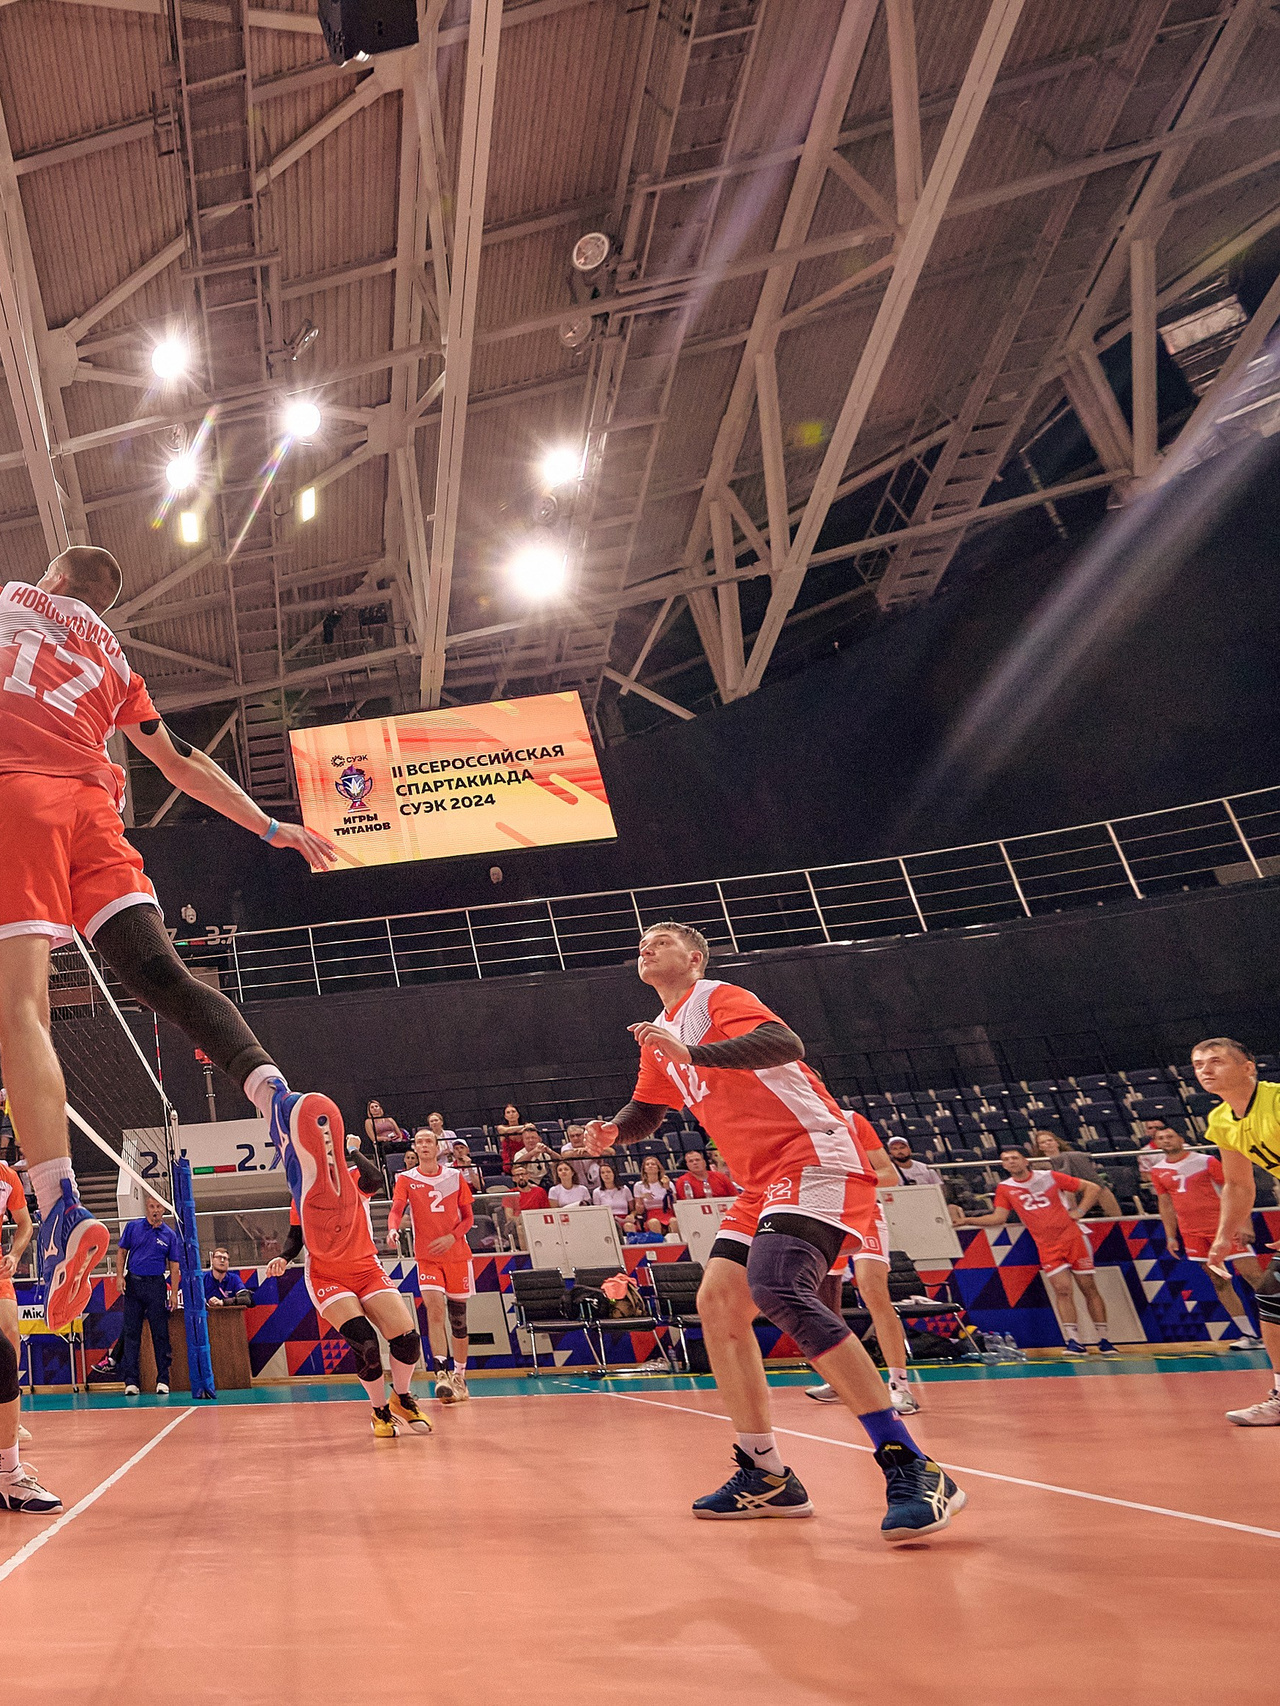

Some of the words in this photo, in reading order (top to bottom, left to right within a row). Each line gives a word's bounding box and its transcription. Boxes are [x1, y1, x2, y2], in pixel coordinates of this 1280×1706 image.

[3, 629, 106, 717] 17
[346, 754, 368, 763] СУЭК
[406, 744, 565, 776] ВСЕРОССИЙСКАЯ
[395, 768, 535, 797] СПАРТАКИАДА
[399, 798, 447, 816] СУЭК
[450, 793, 496, 810] 2024
[333, 822, 392, 836] ТИТАНОВ
[343, 813, 378, 825] ИГРЫ
[666, 1061, 711, 1108] 12
[1171, 1174, 1186, 1193] 7
[428, 1190, 445, 1213] 2
[1019, 1191, 1051, 1211] 25
